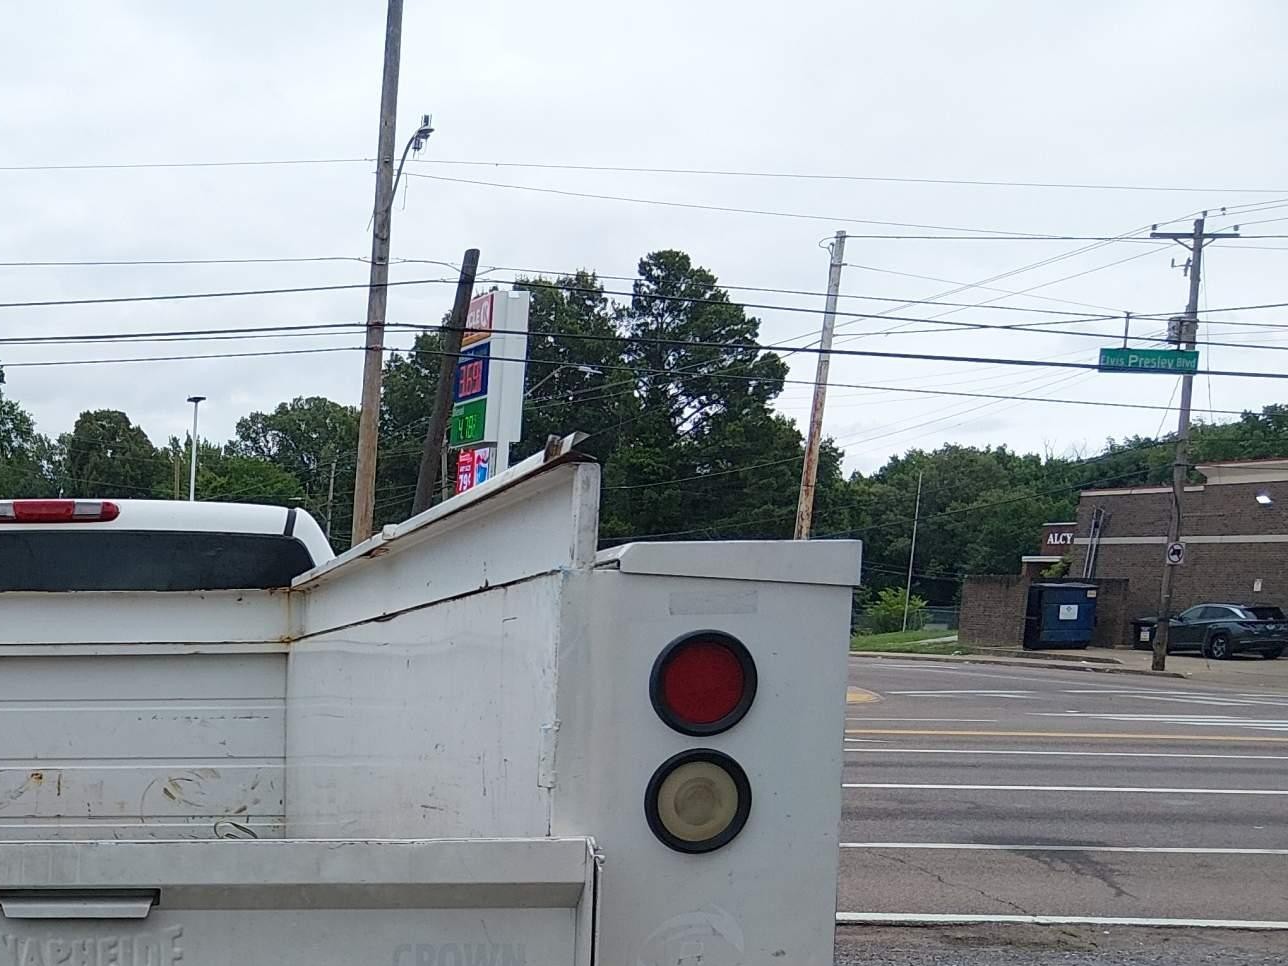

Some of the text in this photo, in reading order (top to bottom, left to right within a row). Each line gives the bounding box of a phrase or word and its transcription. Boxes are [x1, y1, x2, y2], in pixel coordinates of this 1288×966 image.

[1101, 354, 1197, 370] Elvis Presley Blvd
[1046, 532, 1074, 545] ALCY
